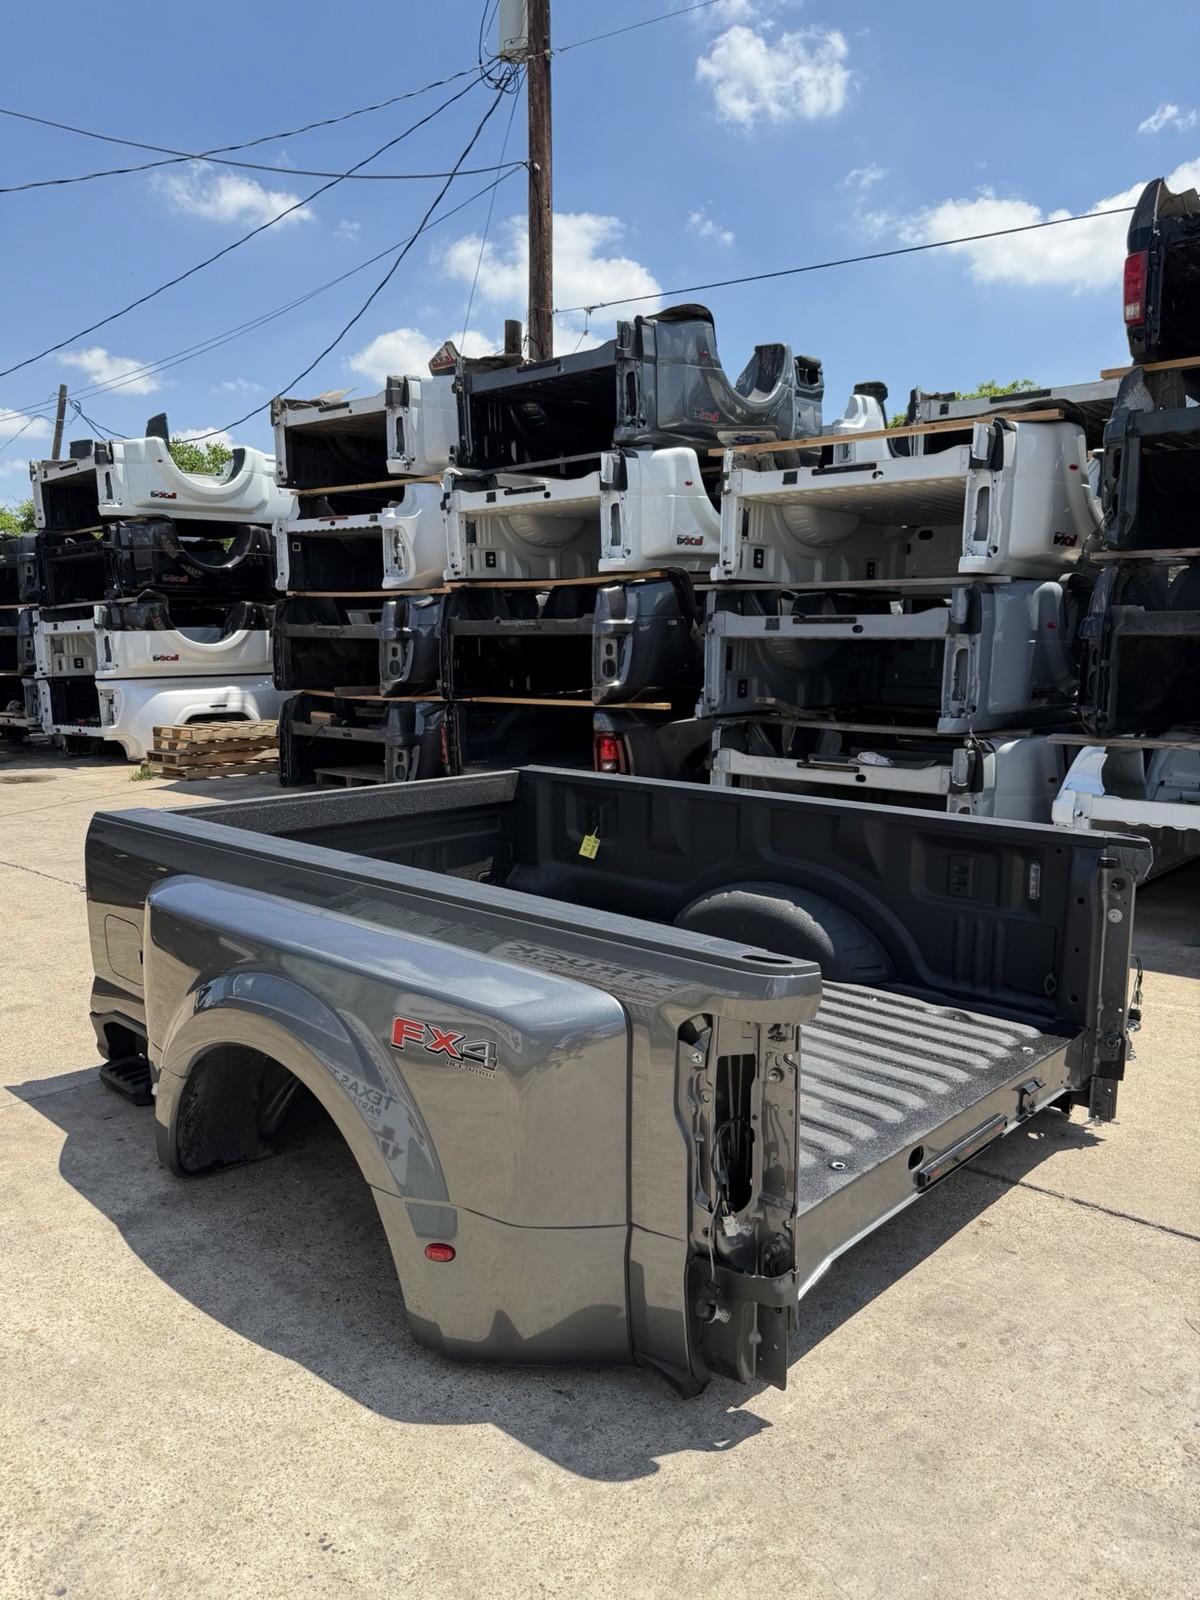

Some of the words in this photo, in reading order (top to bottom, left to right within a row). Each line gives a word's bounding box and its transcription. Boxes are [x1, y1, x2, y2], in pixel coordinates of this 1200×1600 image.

[150, 490, 177, 499] FX4
[676, 535, 704, 546] FX4
[1053, 534, 1078, 547] FX4
[390, 1015, 498, 1072] FX4
